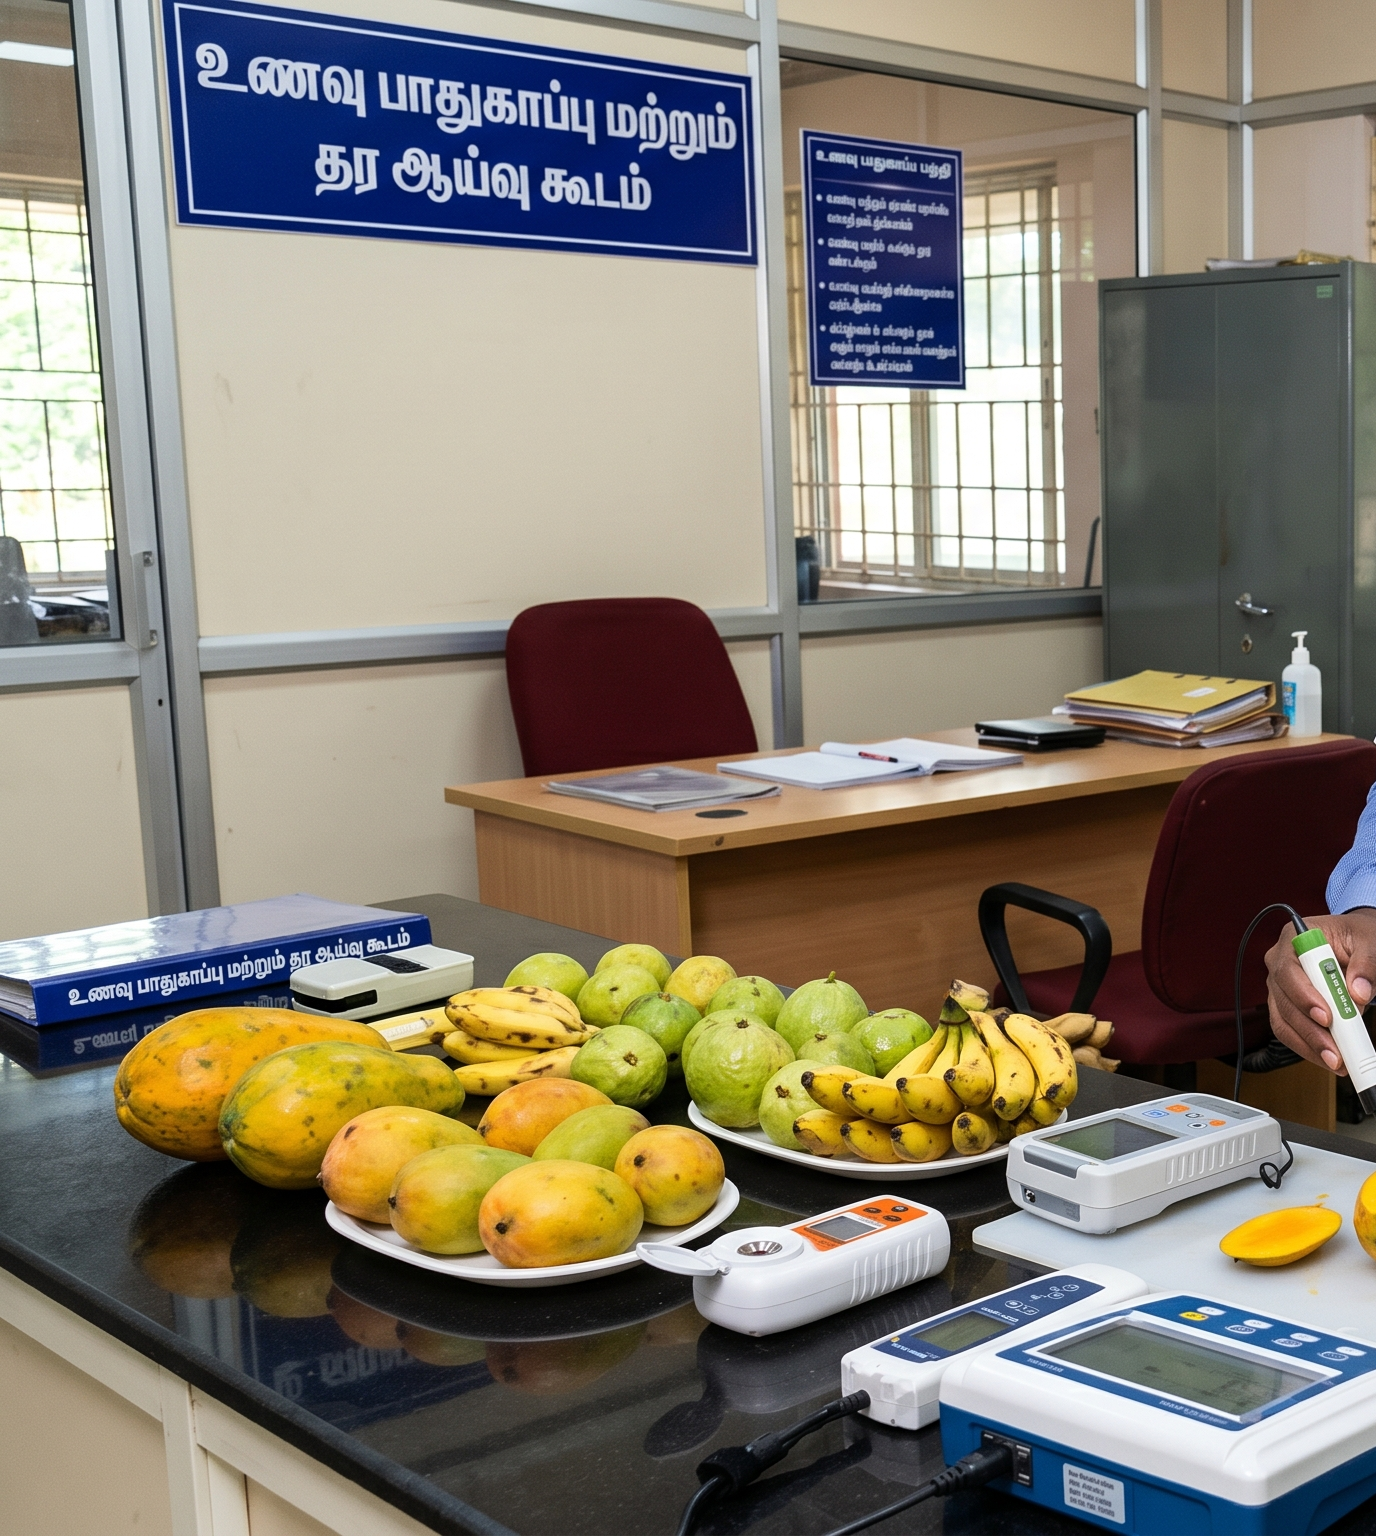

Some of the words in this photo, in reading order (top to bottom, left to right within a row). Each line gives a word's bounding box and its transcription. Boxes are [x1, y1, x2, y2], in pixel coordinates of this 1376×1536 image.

[195, 42, 367, 118] உணவு
[378, 71, 596, 145] பாதுகாப்பு
[605, 91, 738, 161] மற்றும்
[315, 143, 380, 197] தர
[392, 144, 531, 211] ஆய்வு
[540, 162, 653, 212] கூடம்
[68, 981, 134, 1006] உணவு
[137, 962, 224, 996] பாதுகாப்பு
[227, 948, 286, 981] மற்றும்
